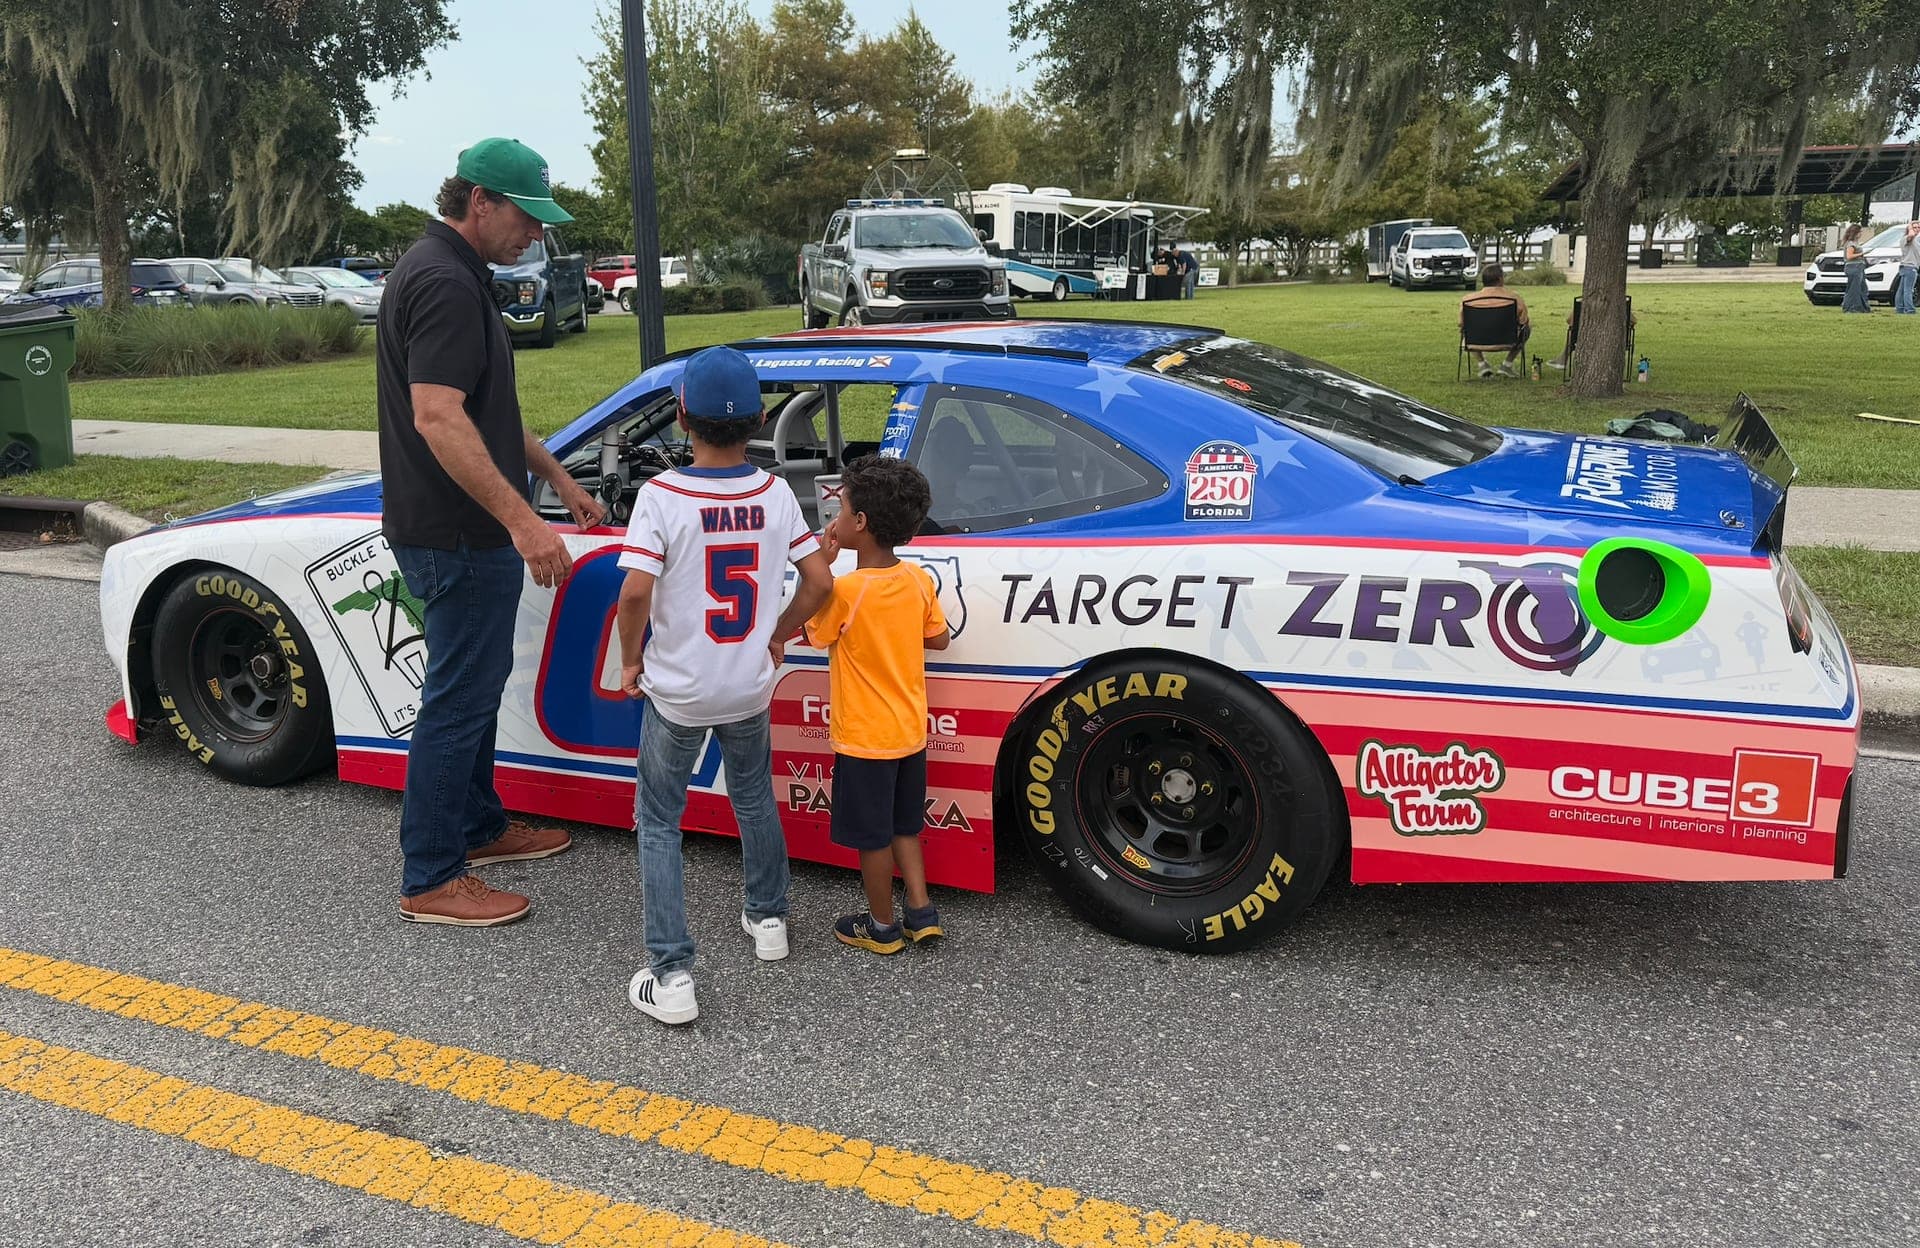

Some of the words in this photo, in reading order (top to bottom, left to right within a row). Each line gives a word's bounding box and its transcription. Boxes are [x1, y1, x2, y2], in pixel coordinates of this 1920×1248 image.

[755, 359, 812, 368] Lagasse
[816, 356, 866, 367] Racing
[726, 401, 734, 413] S
[1190, 476, 1249, 500] 250
[1560, 443, 1639, 510] ROARING
[1639, 454, 1679, 492] MOTOR
[699, 505, 765, 533] WARD
[1192, 508, 1243, 516] FLORIDA
[326, 545, 377, 582] BUCKLE
[705, 542, 760, 644] 5
[1001, 574, 1255, 629] TARGET
[159, 695, 216, 765] EAGLE
[394, 704, 416, 722] IT'S
[927, 740, 965, 753] atment
[1366, 748, 1495, 794] Alligator
[1391, 790, 1477, 828] Farm
[1549, 809, 1642, 826] architecture
[1660, 817, 1725, 834] interiors
[1743, 826, 1807, 845] planning
[1203, 853, 1295, 941] EAGLE
